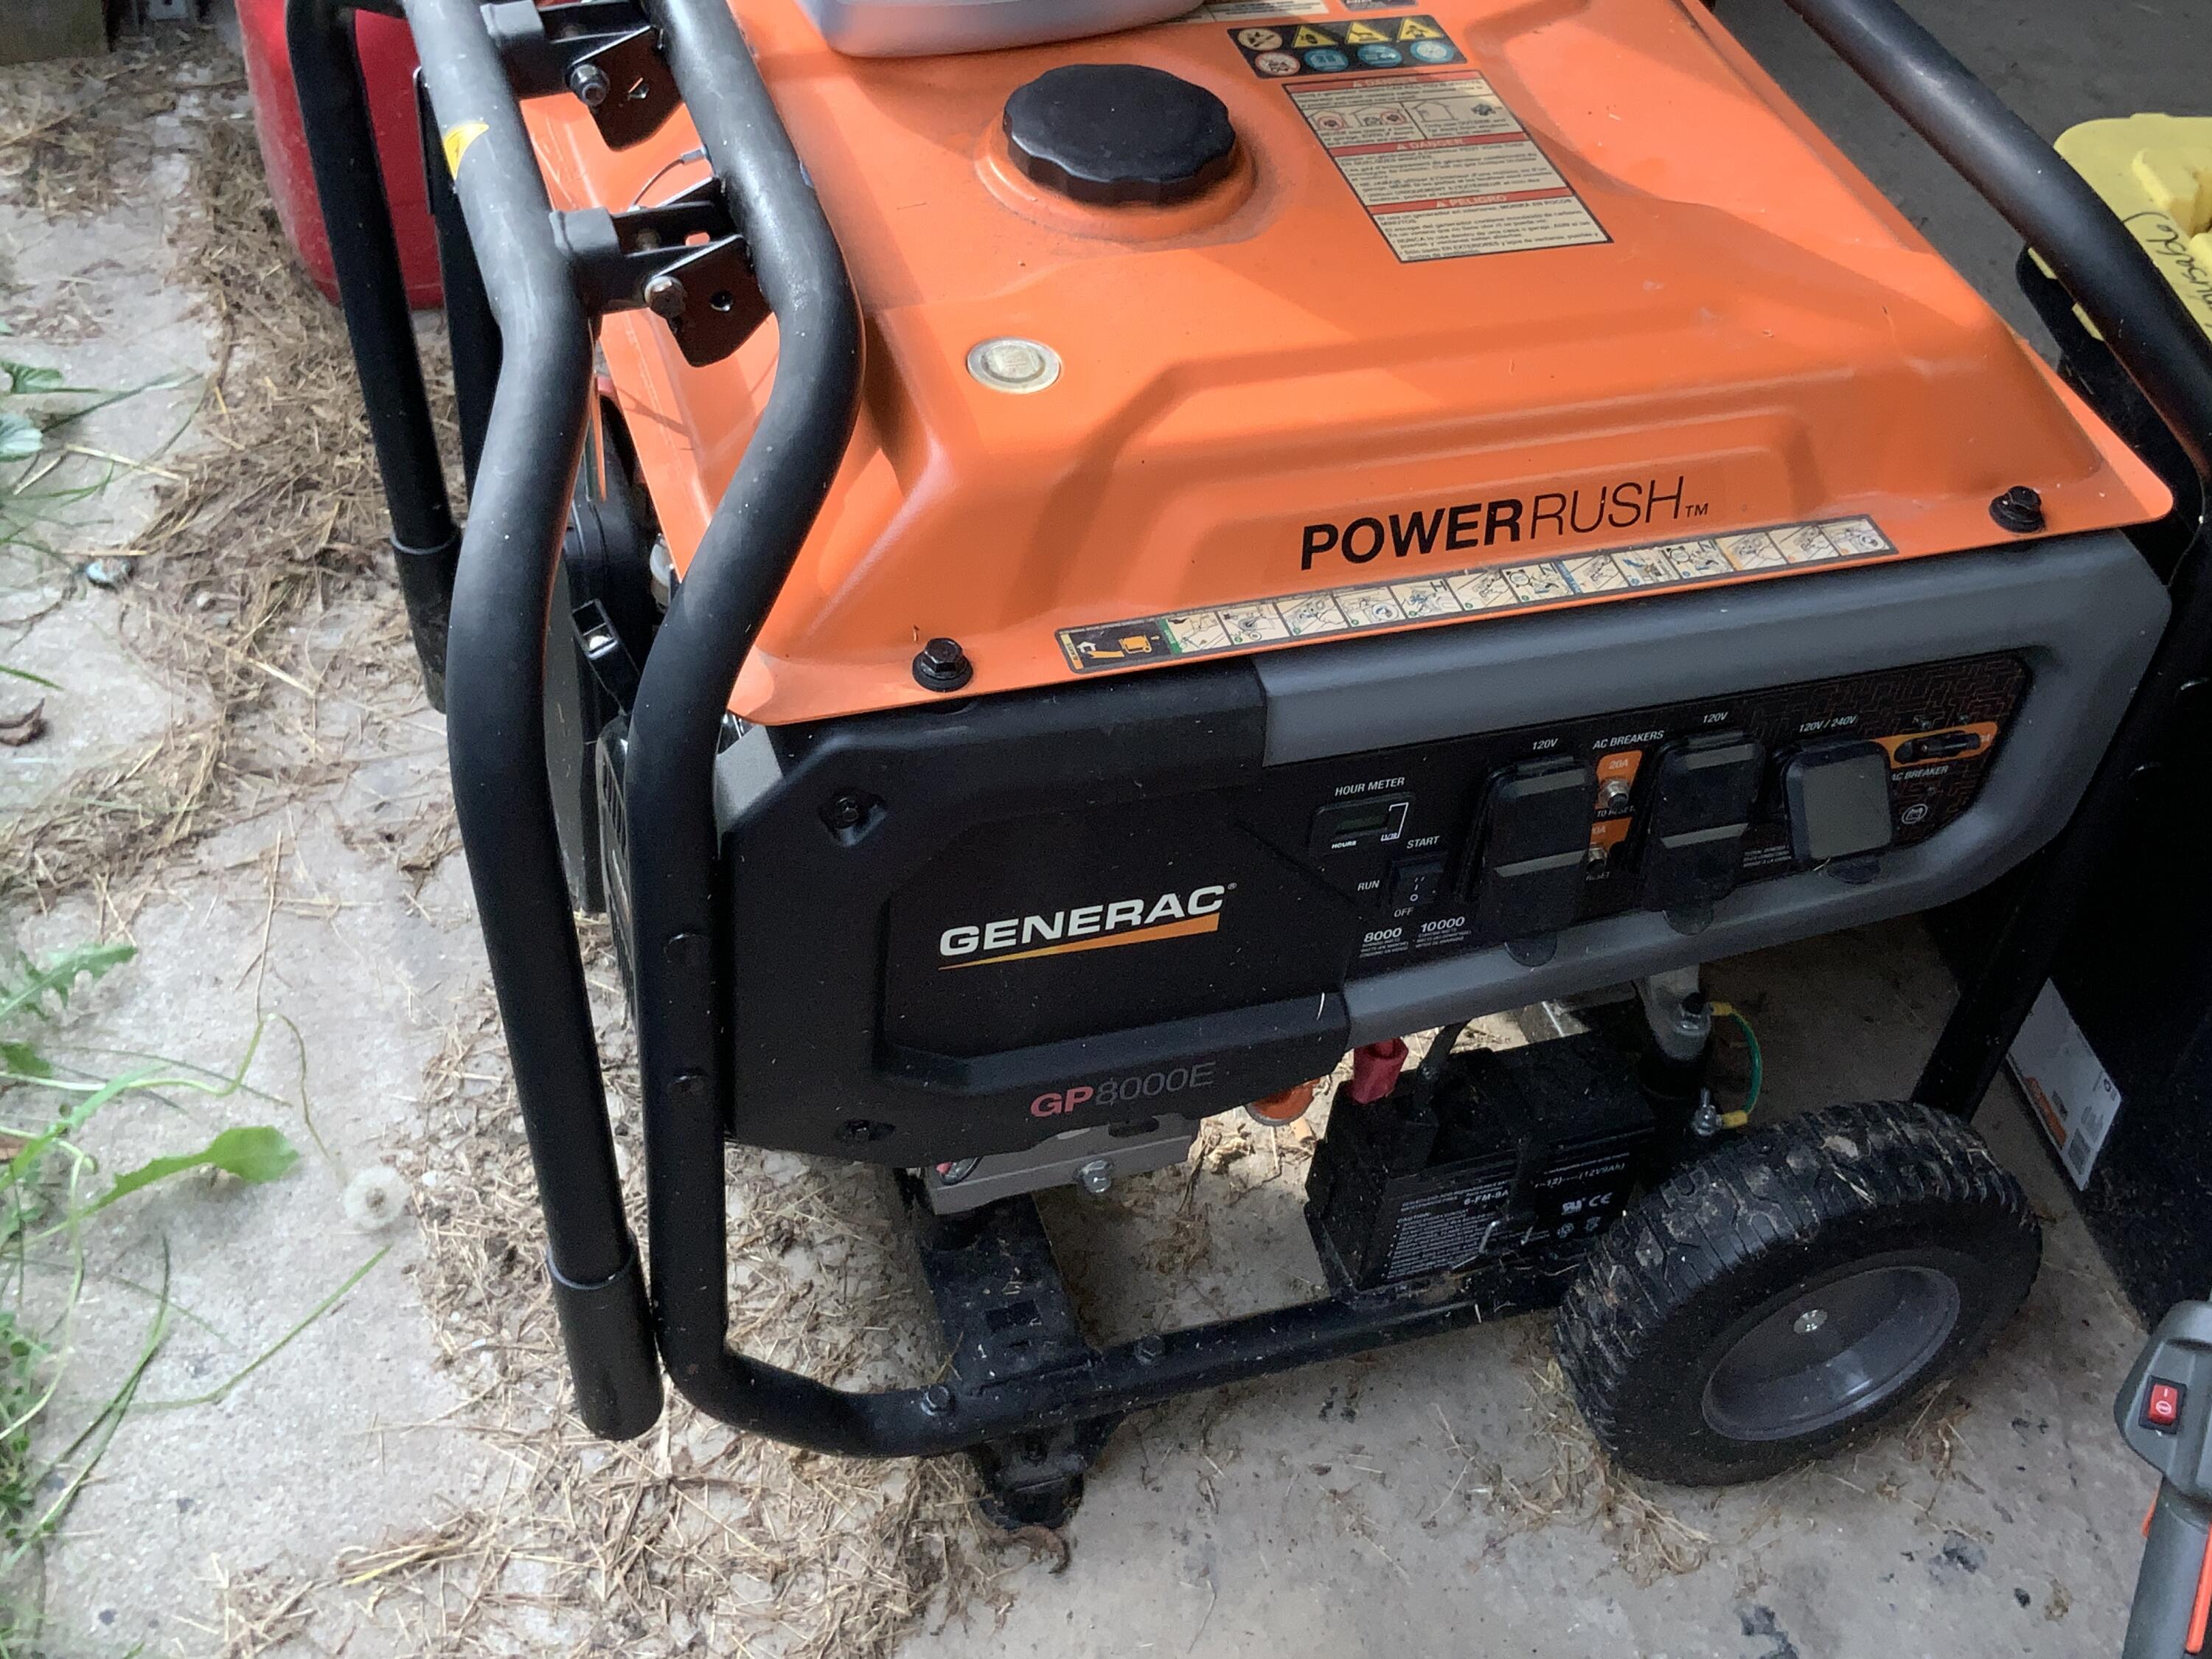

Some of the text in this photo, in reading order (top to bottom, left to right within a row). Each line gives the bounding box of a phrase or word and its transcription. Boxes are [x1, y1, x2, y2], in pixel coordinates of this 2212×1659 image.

[1410, 139, 1464, 150] DANGER
[1449, 195, 1507, 206] PELIGRO
[1703, 712, 1728, 723] 120V
[1799, 720, 1824, 732] 120V
[1831, 714, 1859, 727] 240V
[1532, 738, 1558, 751] 120V
[1593, 730, 1665, 750] AC BREAKERS
[1608, 759, 1630, 770] 20A
[1905, 765, 1949, 782] BREAKER
[1335, 776, 1405, 796] HOUR METER
[1332, 840, 1357, 849] HOURS
[1406, 835, 1440, 849] START
[1357, 880, 1380, 891] RUN
[1394, 906, 1414, 918] OFF
[939, 885, 1225, 956] GENERAC
[1420, 917, 1466, 933] 10000
[1363, 927, 1402, 943] 8000
[1030, 1062, 1217, 1117] GP8000E
